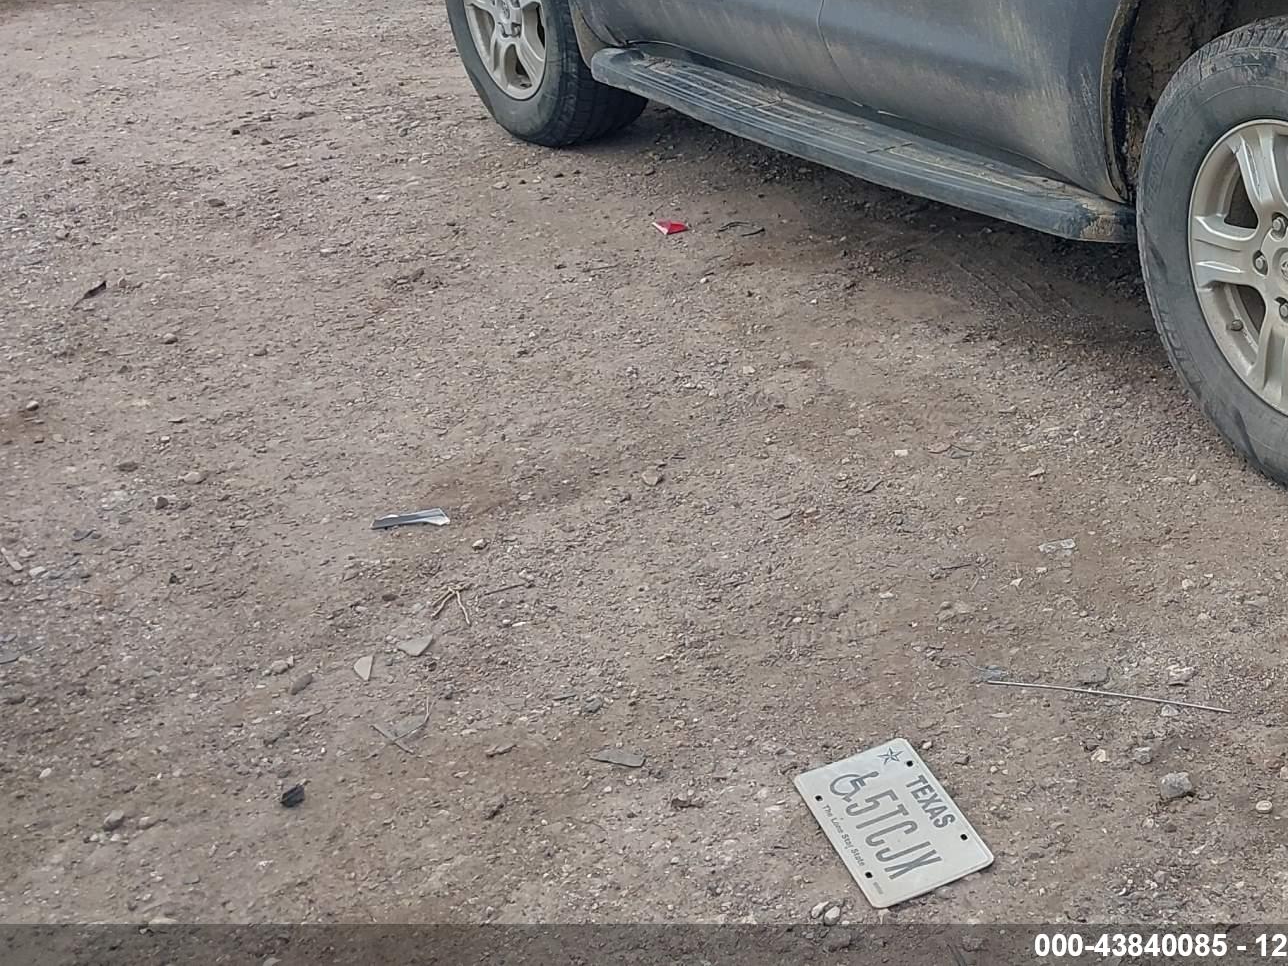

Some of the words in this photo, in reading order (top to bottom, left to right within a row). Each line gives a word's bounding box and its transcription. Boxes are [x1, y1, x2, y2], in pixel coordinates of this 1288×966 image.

[906, 775, 956, 829] TEXAS
[822, 805, 833, 818] The
[831, 815, 844, 835] Lone
[841, 833, 853, 850] Star
[851, 848, 865, 867] State
[845, 789, 943, 880] 5TCJX
